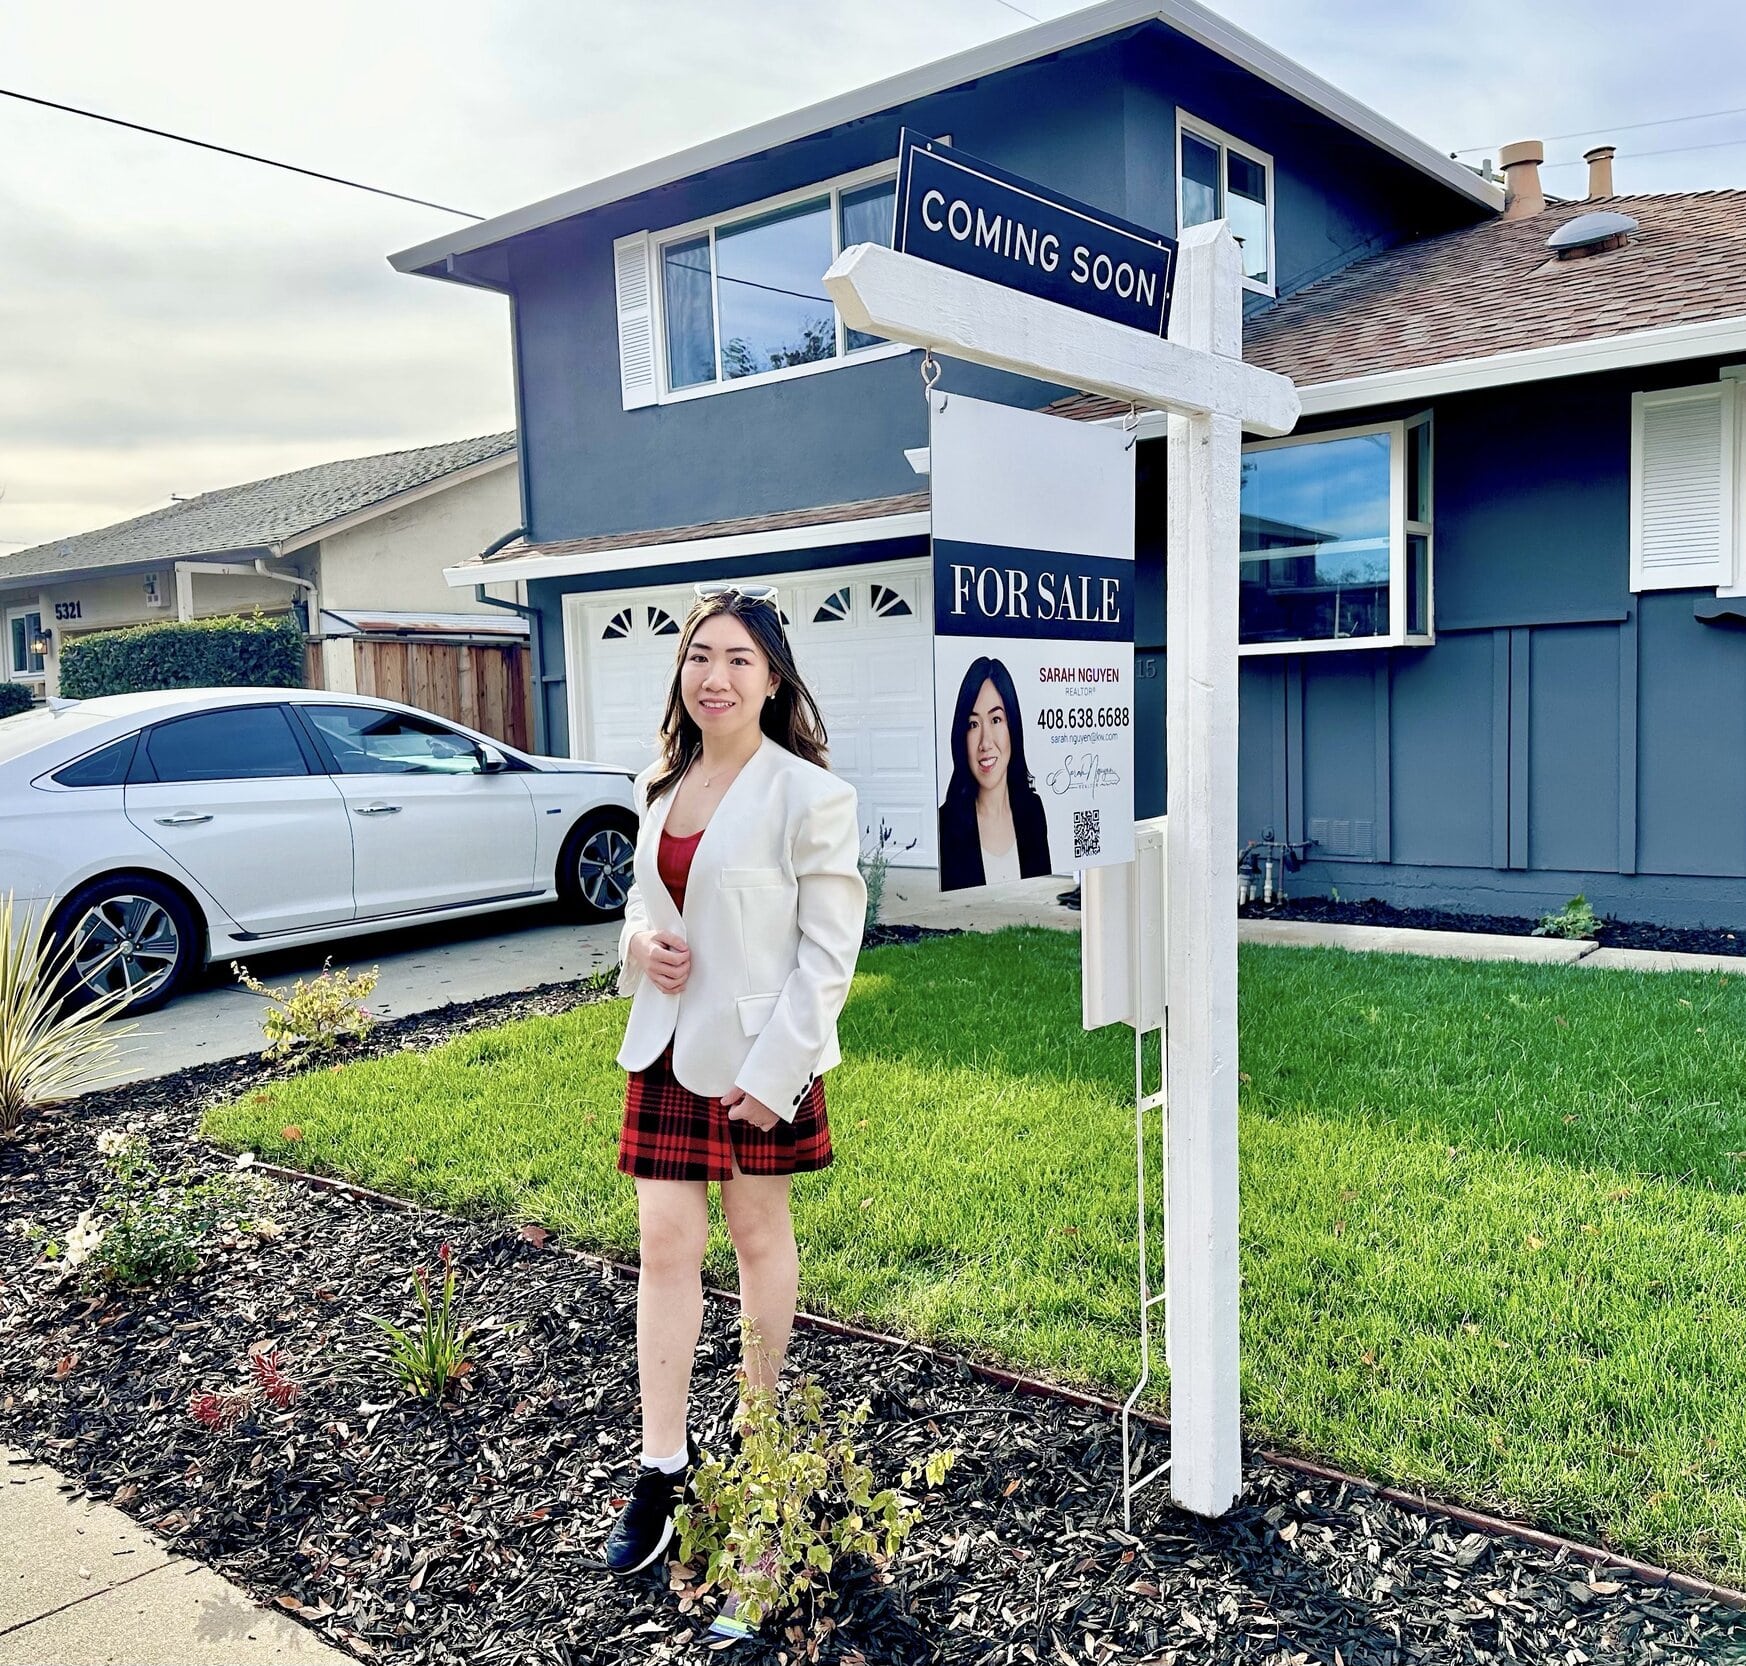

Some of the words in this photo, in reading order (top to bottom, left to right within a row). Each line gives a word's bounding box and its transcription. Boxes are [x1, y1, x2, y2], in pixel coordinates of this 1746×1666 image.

[922, 189, 1060, 273] COMING
[1071, 246, 1157, 307] SOON
[950, 564, 1031, 618] FOR
[1038, 572, 1121, 624] SALE
[55, 600, 82, 620] 5321
[1039, 667, 1076, 682] SARAH
[1078, 668, 1120, 682] NGUYEN
[1037, 707, 1130, 730] 408.638.6688
